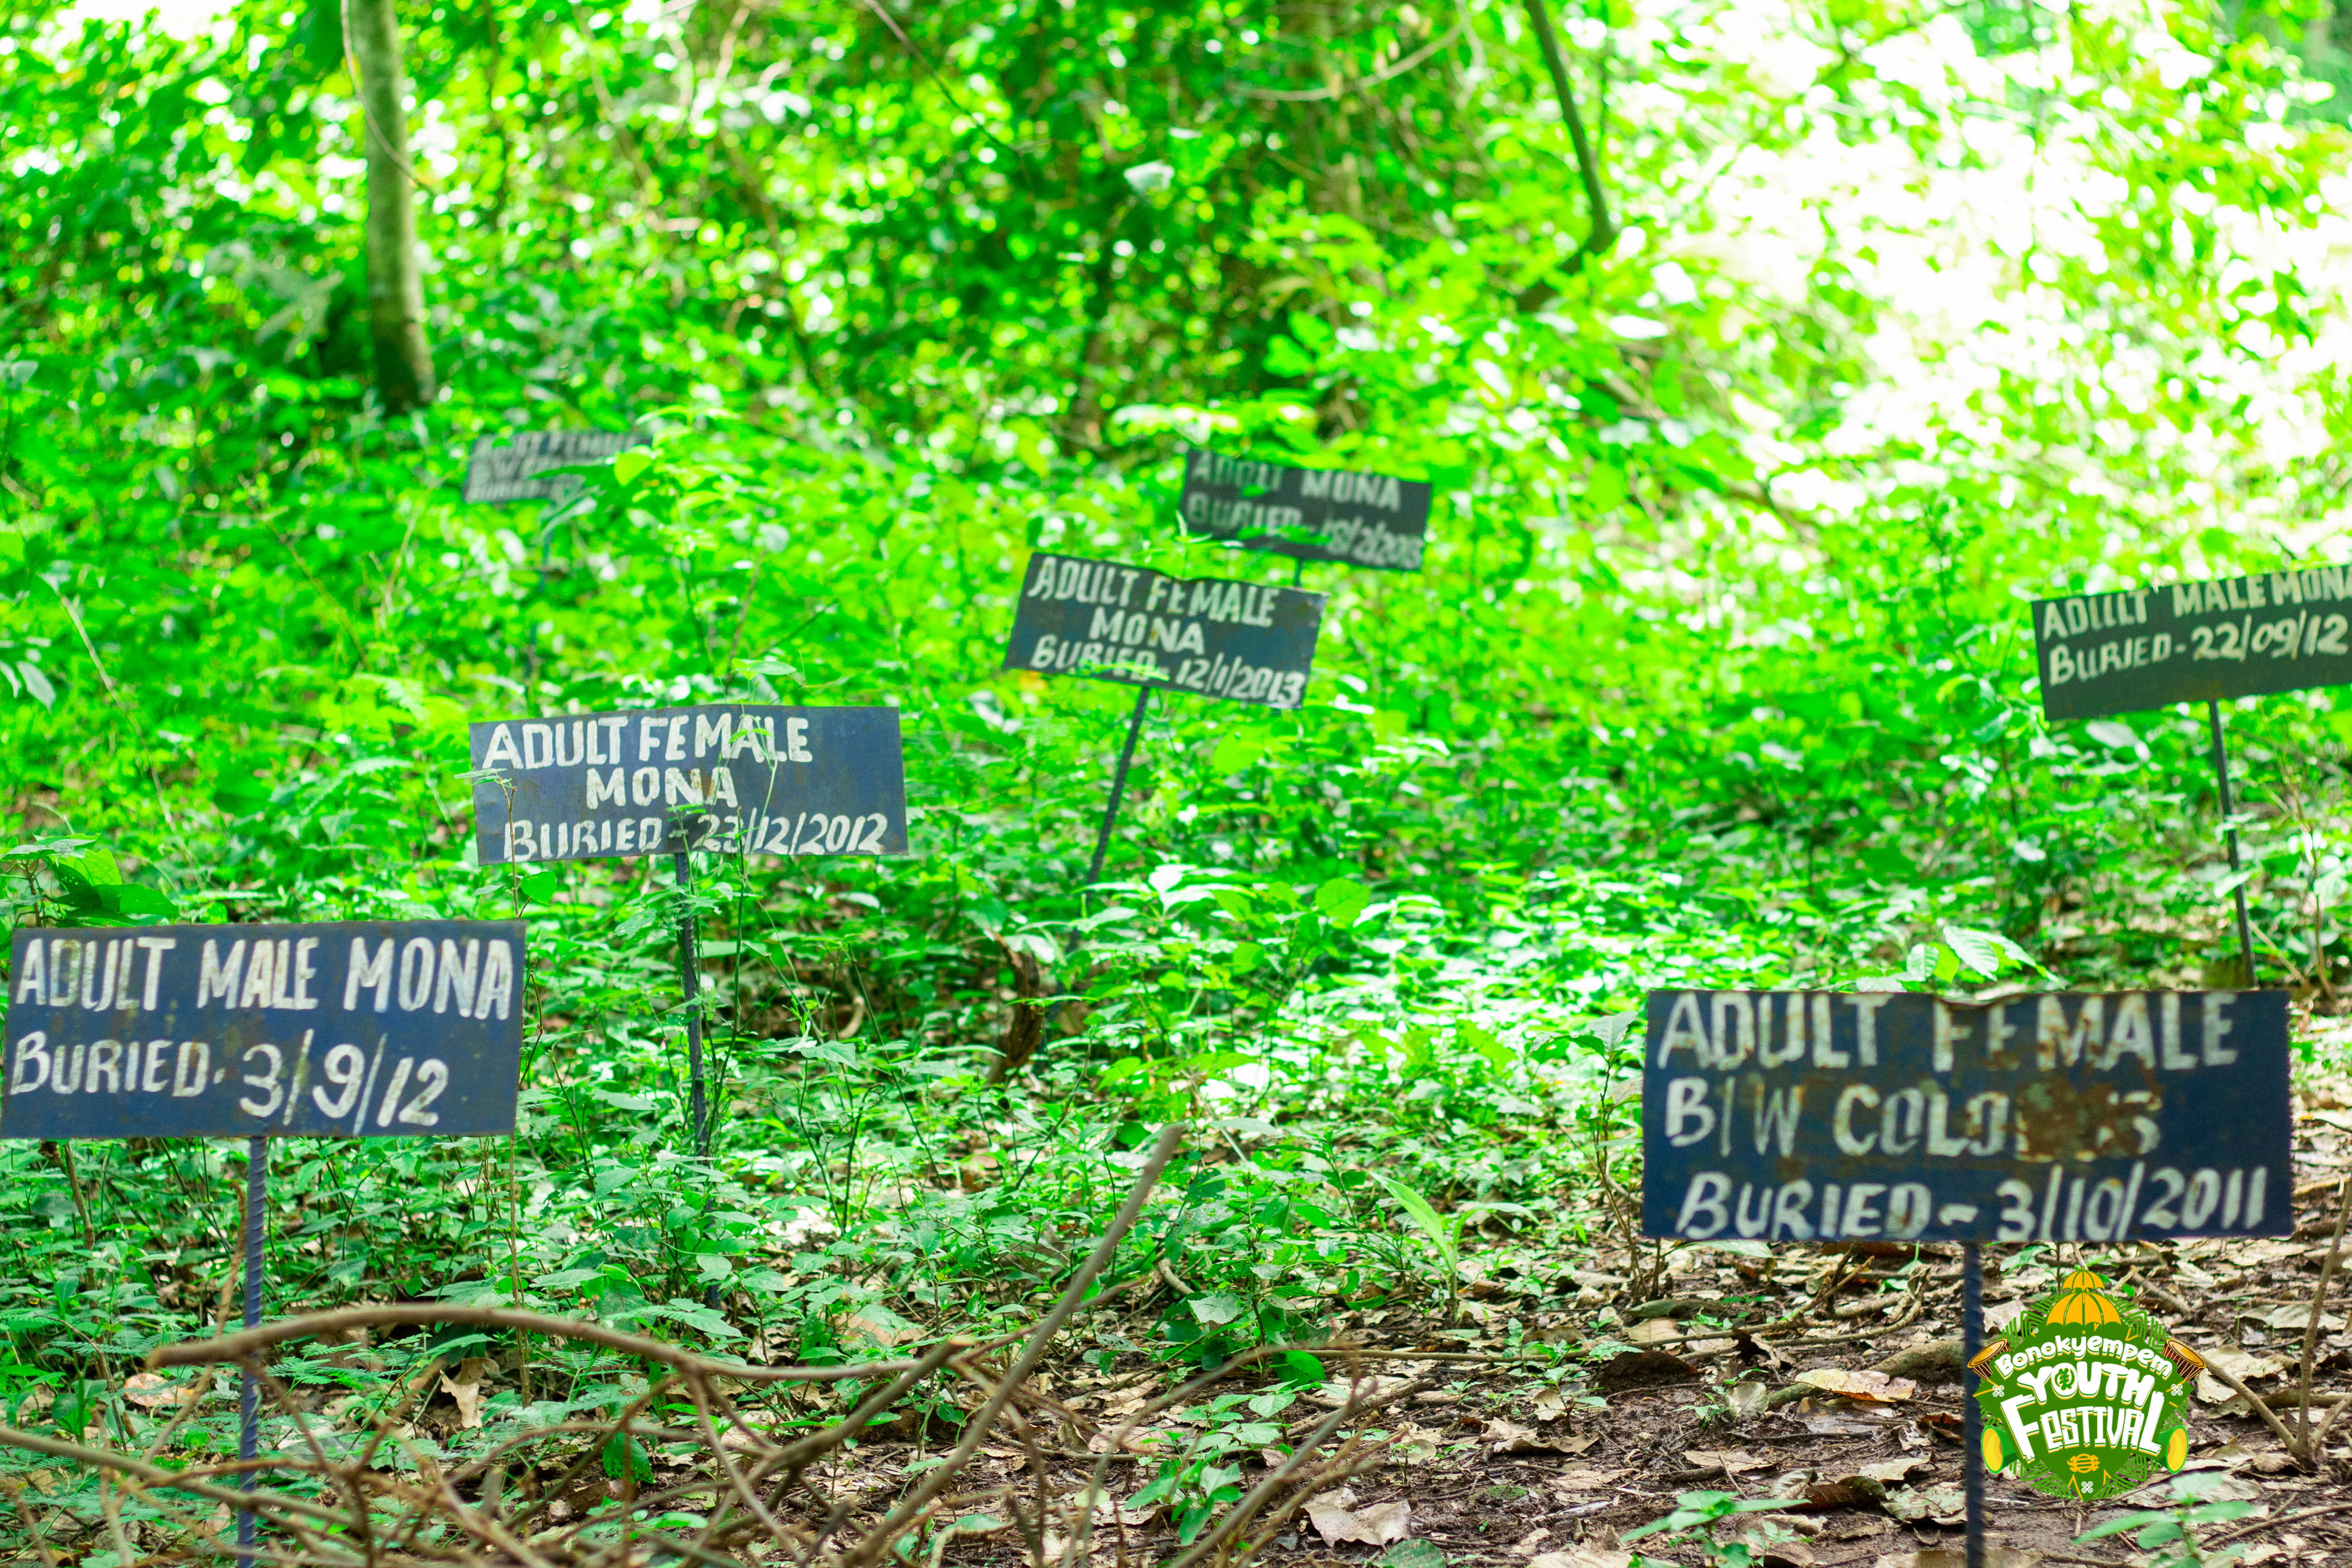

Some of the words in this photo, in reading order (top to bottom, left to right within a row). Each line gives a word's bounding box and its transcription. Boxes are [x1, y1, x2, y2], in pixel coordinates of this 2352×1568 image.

[1028, 556, 1141, 608] ADULT
[1146, 575, 1279, 628] FEMALE
[2043, 587, 2150, 641] ADULT
[2173, 575, 2266, 617] MALE
[1088, 606, 1206, 655] MONA
[2191, 608, 2349, 662] 22/09/12
[482, 715, 629, 770] ADULT
[638, 712, 813, 763] FEMALE
[586, 766, 738, 810] MONA
[692, 807, 888, 855] 23/12/2012
[15, 936, 177, 1012] ADULT
[197, 936, 319, 1010] MALE
[343, 935, 514, 1020] MONA
[1657, 991, 1891, 1071] ADULT
[1932, 990, 2239, 1072] FEMALE
[239, 1028, 450, 1137] 3/9/12
[1996, 1160, 2269, 1242] 3/10/2011
